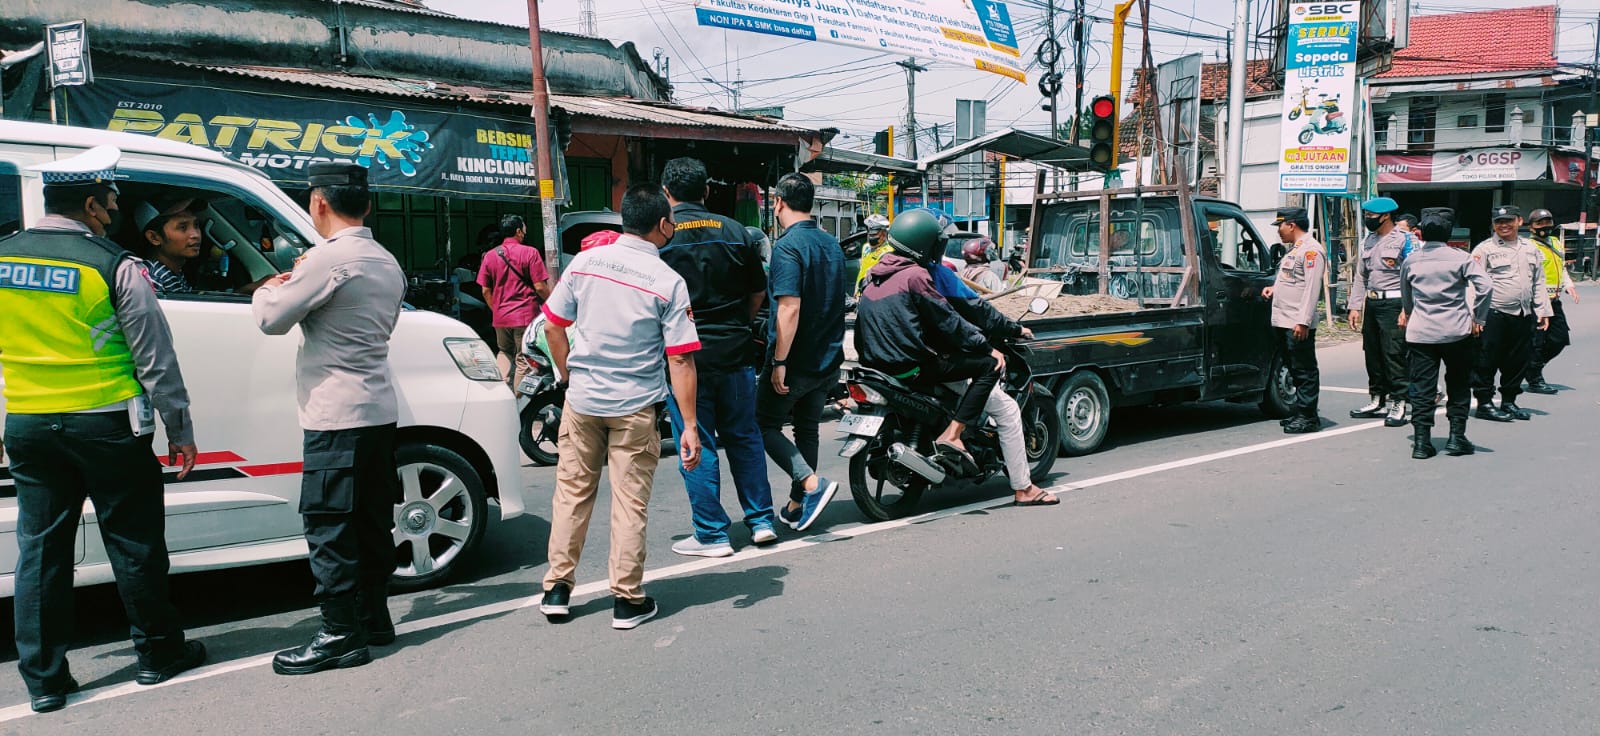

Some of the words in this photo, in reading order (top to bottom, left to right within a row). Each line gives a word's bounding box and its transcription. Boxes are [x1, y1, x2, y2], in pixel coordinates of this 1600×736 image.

[710, 0, 746, 10] Fakultas
[748, 3, 792, 17] Kedokteran
[793, 11, 809, 21] Gigi
[815, 2, 849, 15] Juara
[1309, 4, 1353, 15] SBC
[709, 15, 729, 24] NON
[731, 17, 745, 27] IPA
[746, 20, 753, 28] &
[754, 20, 772, 31] SMK
[774, 23, 790, 33] bisa
[791, 27, 812, 36] daftar
[1298, 25, 1350, 38] SERBU
[1295, 51, 1348, 65] Sepeda
[1298, 65, 1344, 78] Listrik
[117, 101, 135, 109] EST
[136, 102, 163, 111] 2010
[106, 108, 413, 159] PATRICK
[476, 128, 532, 149] BERSIH
[489, 144, 533, 161] TEPAT
[1303, 152, 1345, 161] JUTAAN
[1477, 151, 1522, 166] GGSP
[456, 156, 536, 177] KINCLONG
[0, 265, 76, 290] POLISI
